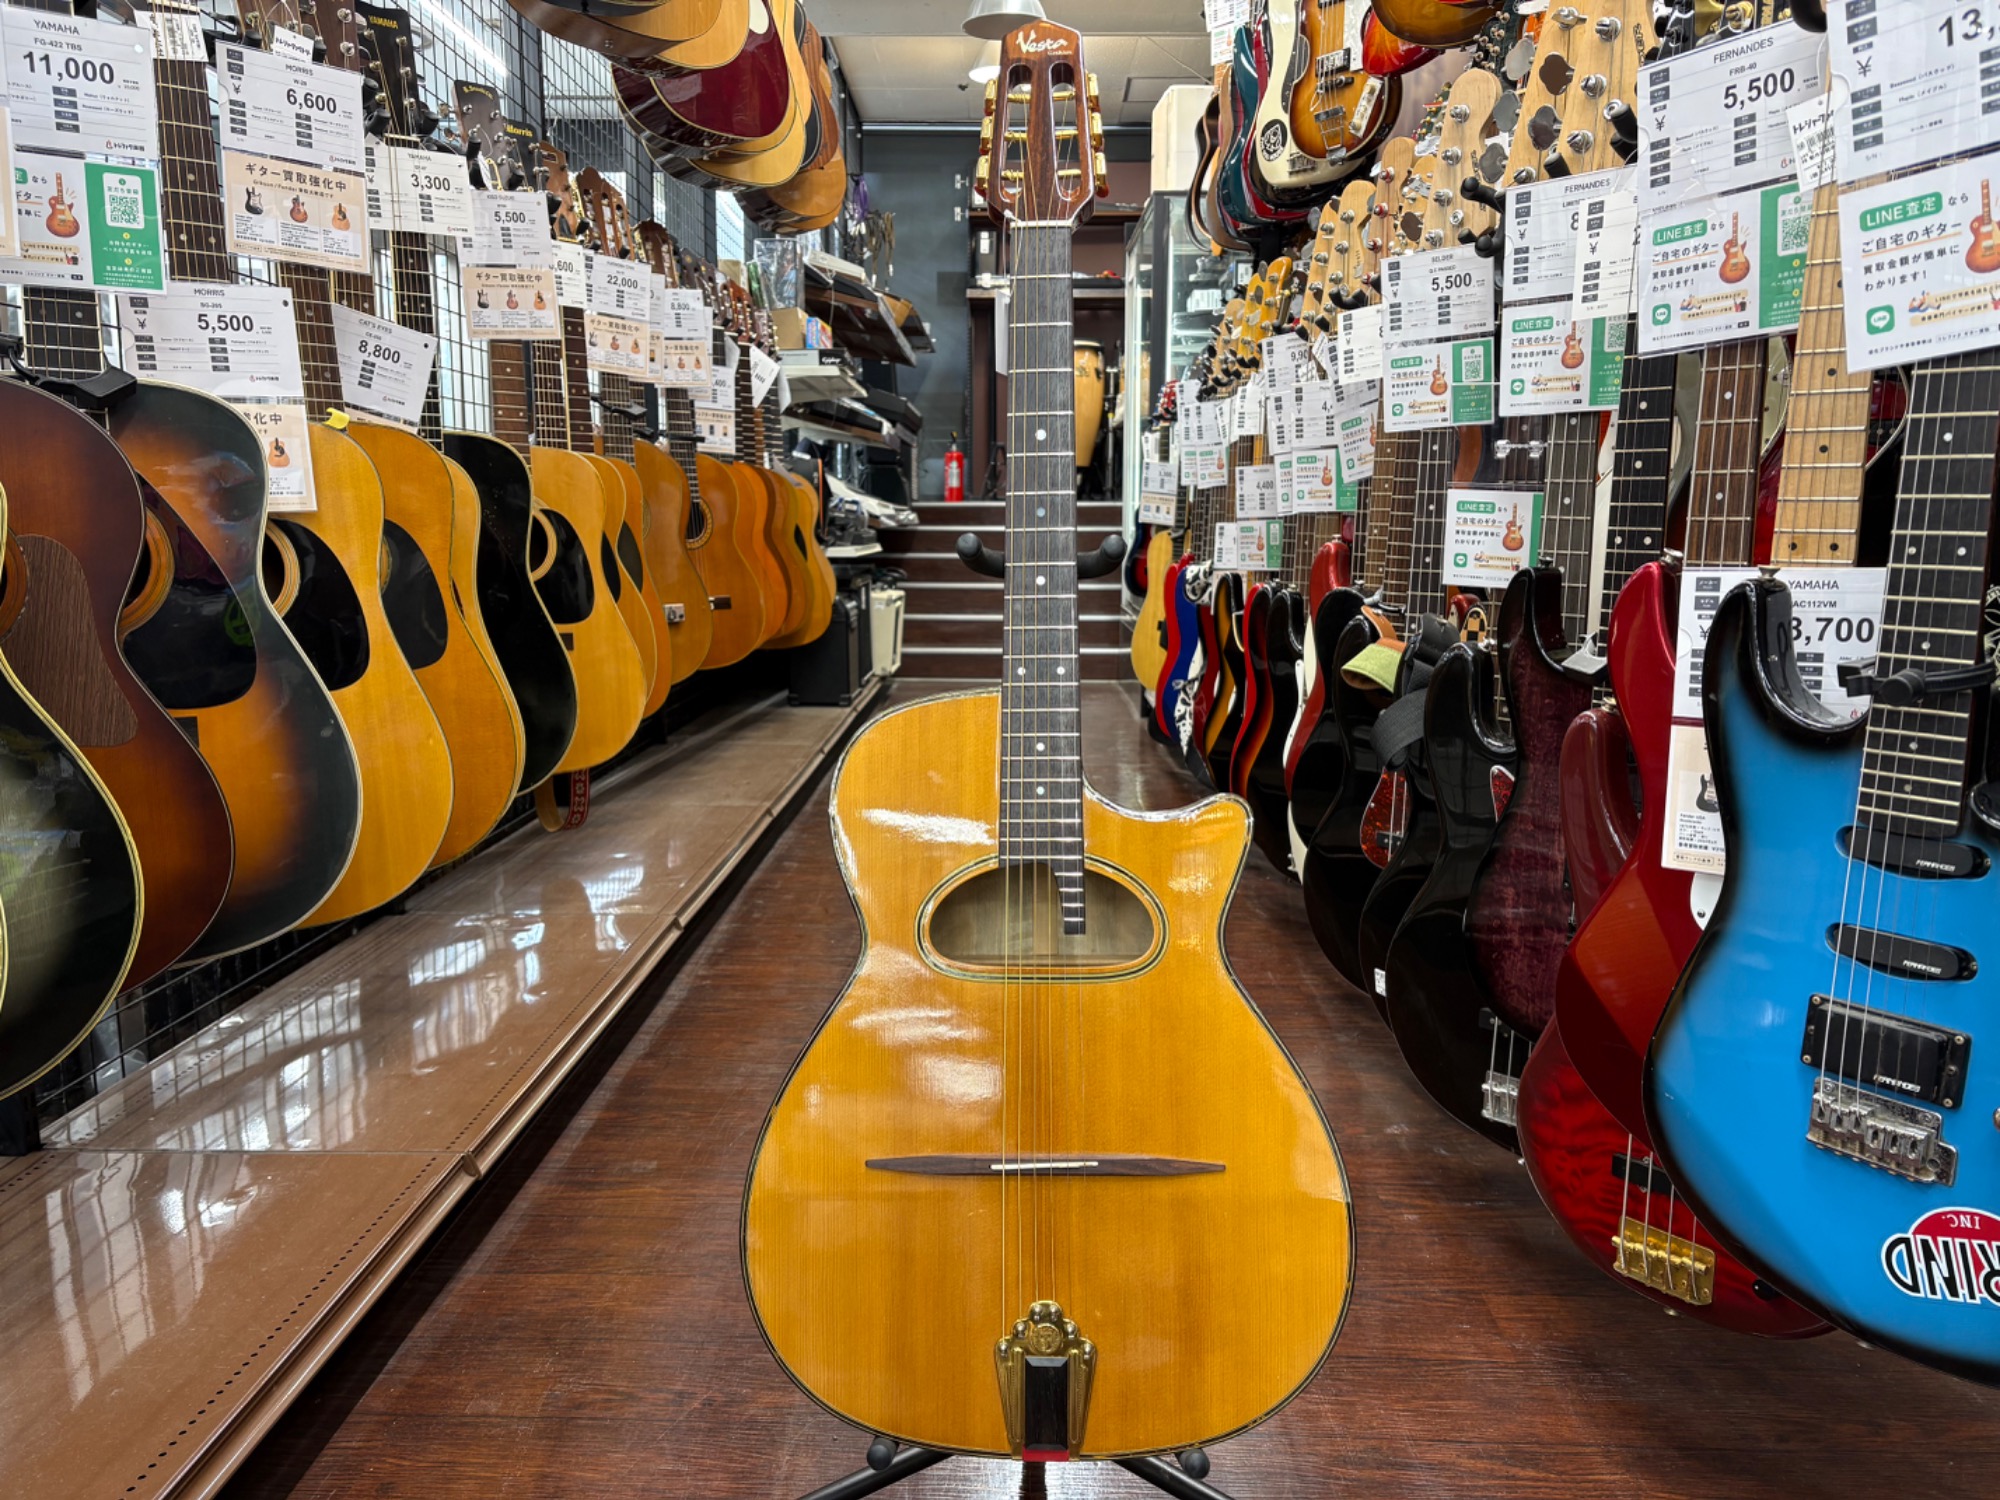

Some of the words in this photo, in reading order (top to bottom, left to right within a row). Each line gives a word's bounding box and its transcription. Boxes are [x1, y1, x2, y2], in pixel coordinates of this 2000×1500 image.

[33, 19, 80, 36] YAMAHA
[368, 15, 399, 30] YAMAHA
[1939, 5, 2000, 47] 13,
[34, 37, 64, 49] FG-422
[1016, 29, 1068, 54] Vesta
[1713, 38, 1774, 64] FERNANDES
[23, 51, 115, 85] 11,000
[1729, 62, 1758, 77] FRB-40
[1855, 55, 1873, 78] ¥
[231, 82, 242, 96] ¥
[1723, 67, 1796, 111] 5,500
[286, 87, 338, 115] 6,600
[1655, 114, 1667, 133] ¥
[245, 161, 347, 193] ギター買取強化中
[410, 173, 451, 192] 3,300
[1564, 178, 1611, 195] FERNANDES
[494, 211, 526, 224] 5,500
[1866, 196, 1937, 228] LINE査定
[1948, 192, 1969, 207] なら
[1657, 221, 1704, 244] LINE査定
[1710, 221, 1726, 232] なら
[1861, 221, 1963, 255] ご自宅のギター
[1589, 241, 1599, 255] ¥
[1652, 241, 1720, 264] ご自宅のギター
[1863, 243, 1961, 276] 買取金額が簡単に
[475, 272, 543, 284] ギター買取強化中
[1652, 260, 1717, 280] 買取金額が簡単に
[607, 274, 639, 290] 22,000
[1431, 273, 1473, 293] 5,500
[193, 287, 225, 297] MORRIS
[136, 317, 147, 330] ¥
[197, 313, 255, 334] 5,500
[358, 318, 375, 330] CAT'S
[376, 323, 393, 335] EYES
[1511, 335, 1562, 346] ご自宅のギター
[358, 338, 401, 365] 8,800
[1456, 516, 1504, 526] ご自宅のギター
[1788, 579, 1840, 591] YAMAHA
[1915, 859, 1957, 873] FERNANDES
[1902, 960, 1943, 975] FERNANDES
[1872, 1073, 1921, 1094] FERNANDES
[1941, 1213, 1982, 1230] INC.
[1882, 1234, 2000, 1306] RIND
